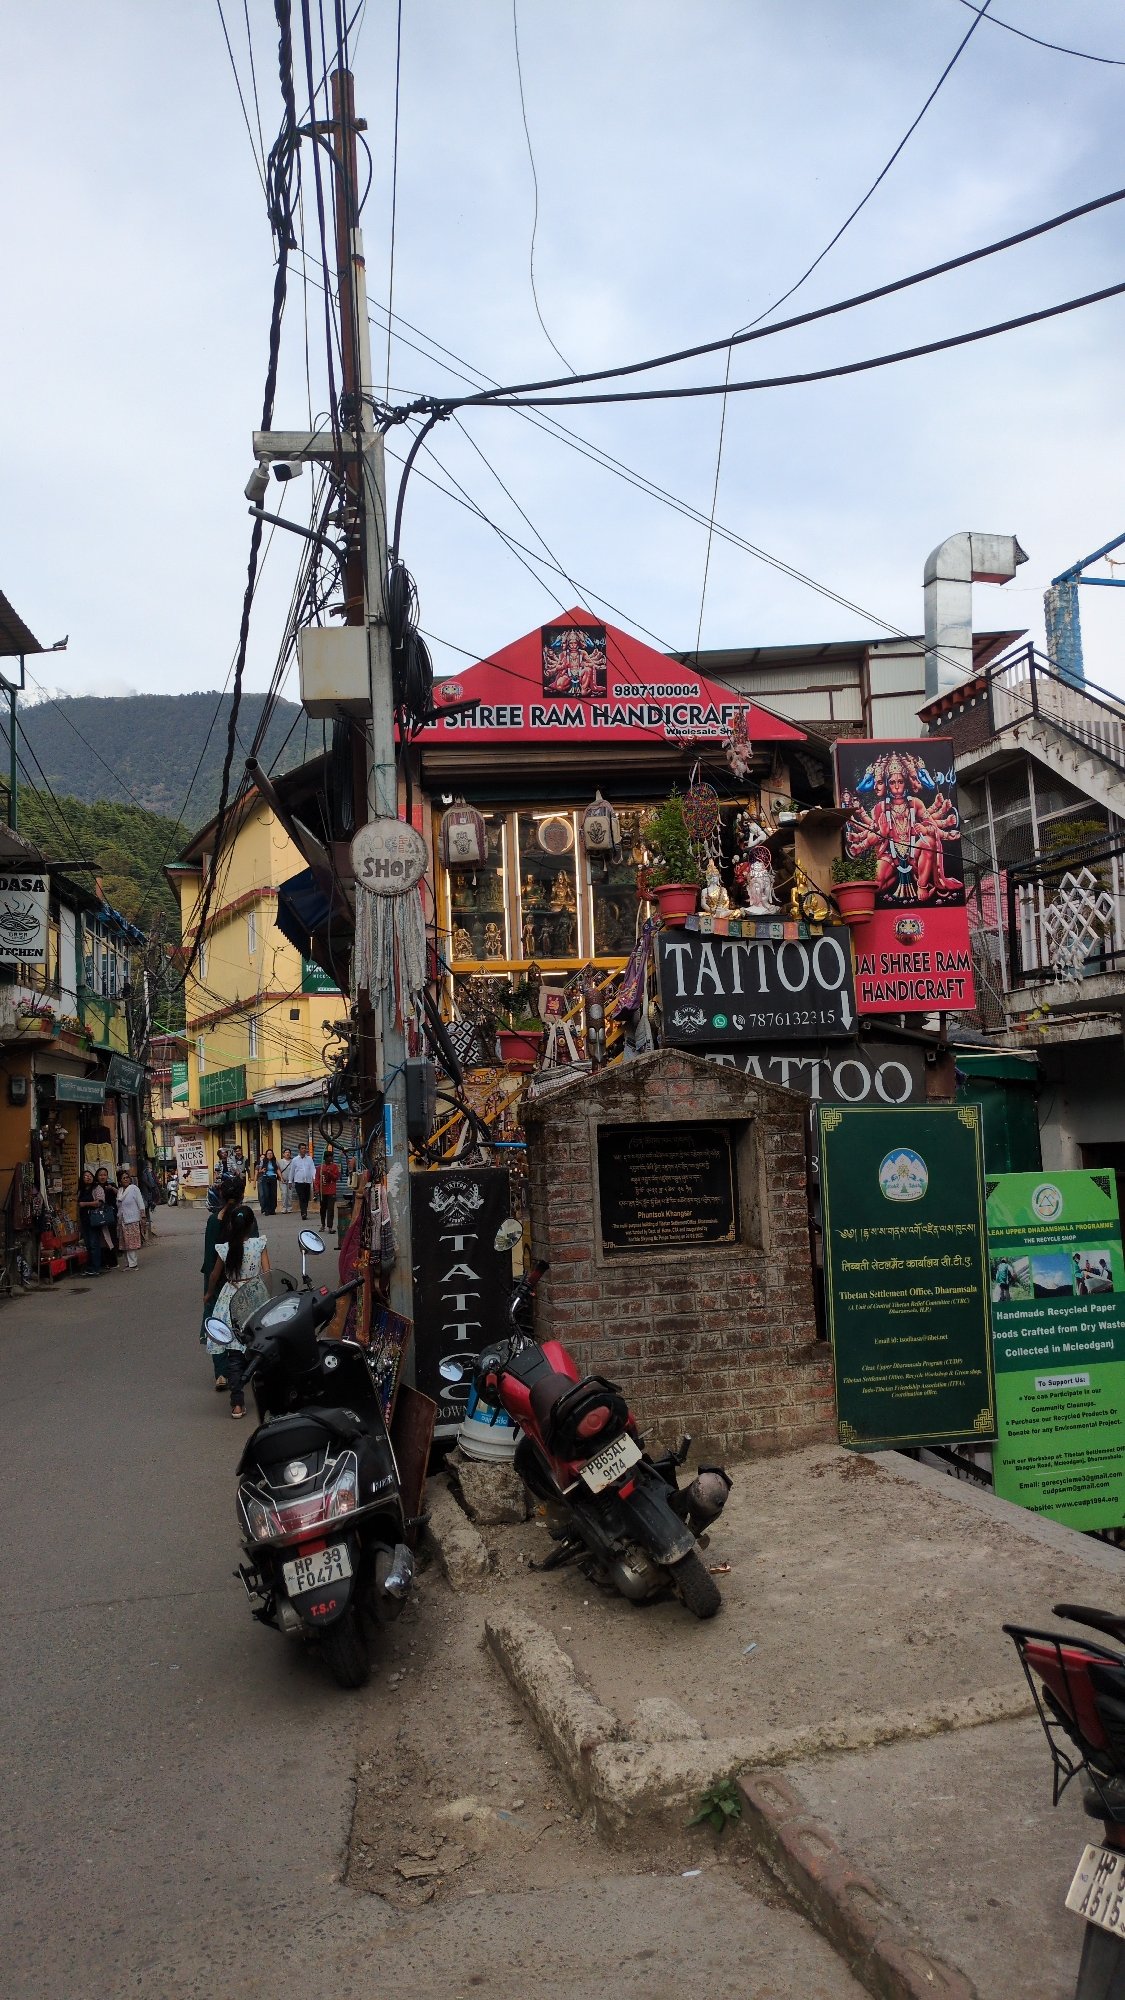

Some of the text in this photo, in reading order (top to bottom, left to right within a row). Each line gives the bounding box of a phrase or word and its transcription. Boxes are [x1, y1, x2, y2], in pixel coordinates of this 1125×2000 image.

[614, 684, 700, 698] 9807100004
[445, 703, 524, 729] SHREE
[530, 703, 586, 729] RAM
[591, 703, 750, 729] HANDICRAFT
[665, 728, 715, 737] Wholesale
[363, 857, 413, 878] SHOP
[665, 937, 846, 996] TATTOO
[881, 950, 932, 975] SHREE
[936, 949, 972, 972] RAM
[862, 977, 967, 1003] HANDICRAFT
[750, 1011, 836, 1028] 7876132315
[988, 1226, 1004, 1236] LEAN
[1006, 1225, 1027, 1235] UPPER
[1076, 1222, 1115, 1231] PROGRAMME
[1037, 1235, 1061, 1243] RECYCLE
[839, 1283, 978, 1301] Tibetan Settlement Office, Dharamsala
[996, 1303, 1117, 1320] Handmade Recycled Paper
[1021, 1326, 1056, 1338] Crafted
[1058, 1324, 1079, 1335] from
[1081, 1321, 1097, 1333] Dry
[1098, 1320, 1125, 1331] Waste
[1005, 1339, 1115, 1358] Collected in Mcleodganj
[1038, 1376, 1086, 1388] To Support Us:
[1050, 1389, 1083, 1399] Participate
[1031, 1403, 1066, 1413] Community
[1011, 1416, 1041, 1426] Purchase
[1053, 1413, 1082, 1424] Recycled
[1082, 1410, 1109, 1420] Products
[1008, 1428, 1031, 1438] Donate
[1032, 1427, 1041, 1435] for
[1042, 1426, 1054, 1435] any
[1055, 1422, 1098, 1433] Environmental
[586, 1442, 627, 1476] PB65AL
[1003, 1458, 1016, 1466] Visit
[1064, 1451, 1085, 1460] Tibetan
[603, 1458, 627, 1481] 9174
[1019, 1482, 1041, 1491] Email:
[294, 1547, 342, 1576] HP 39
